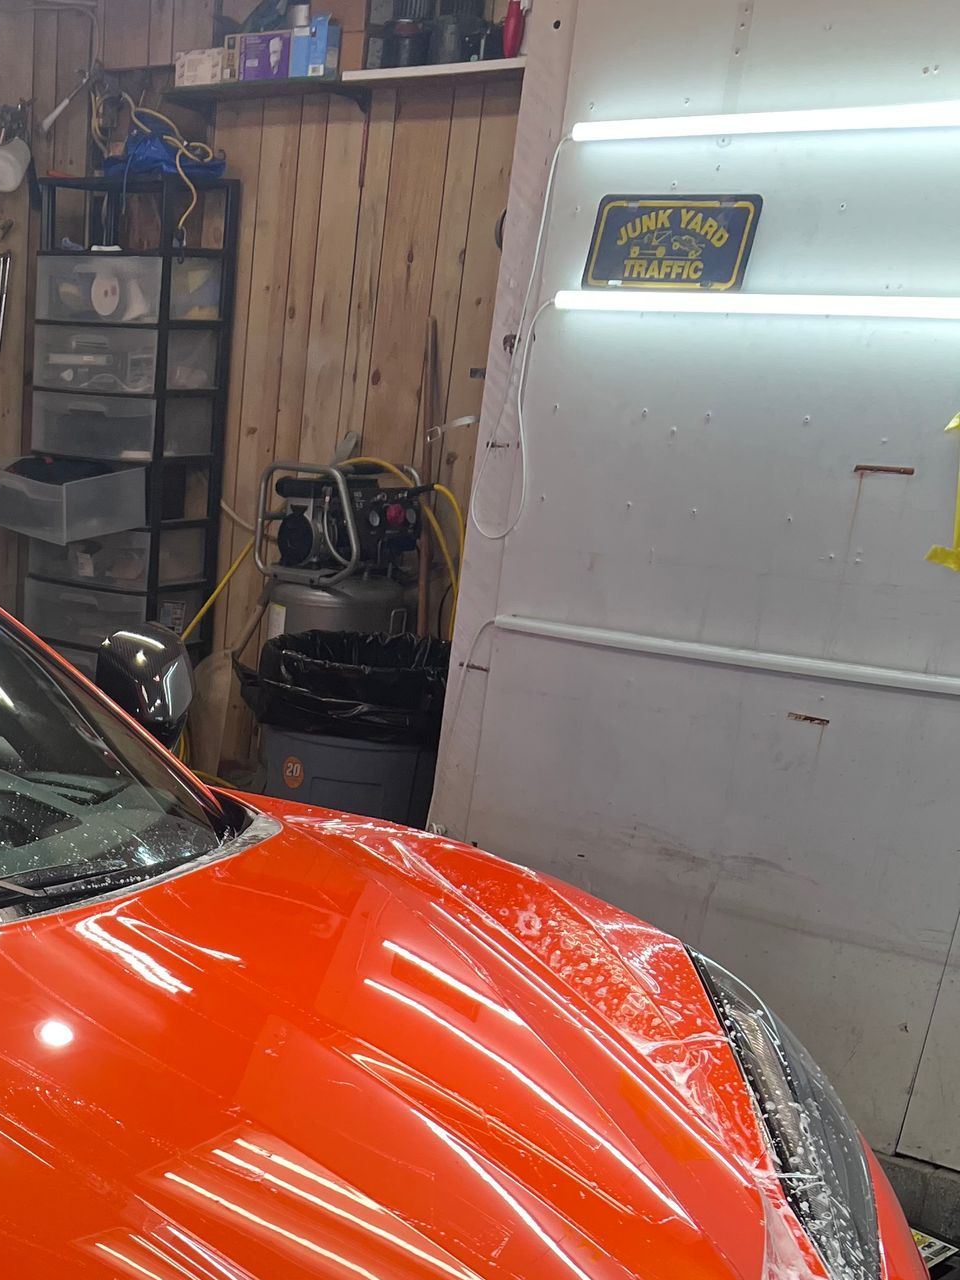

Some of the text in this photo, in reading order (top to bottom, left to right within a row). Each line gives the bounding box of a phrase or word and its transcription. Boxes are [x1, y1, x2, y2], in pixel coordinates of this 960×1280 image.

[616, 208, 729, 248] JUNK YARD
[623, 260, 705, 280] TRAFFIC
[286, 762, 301, 777] 20
